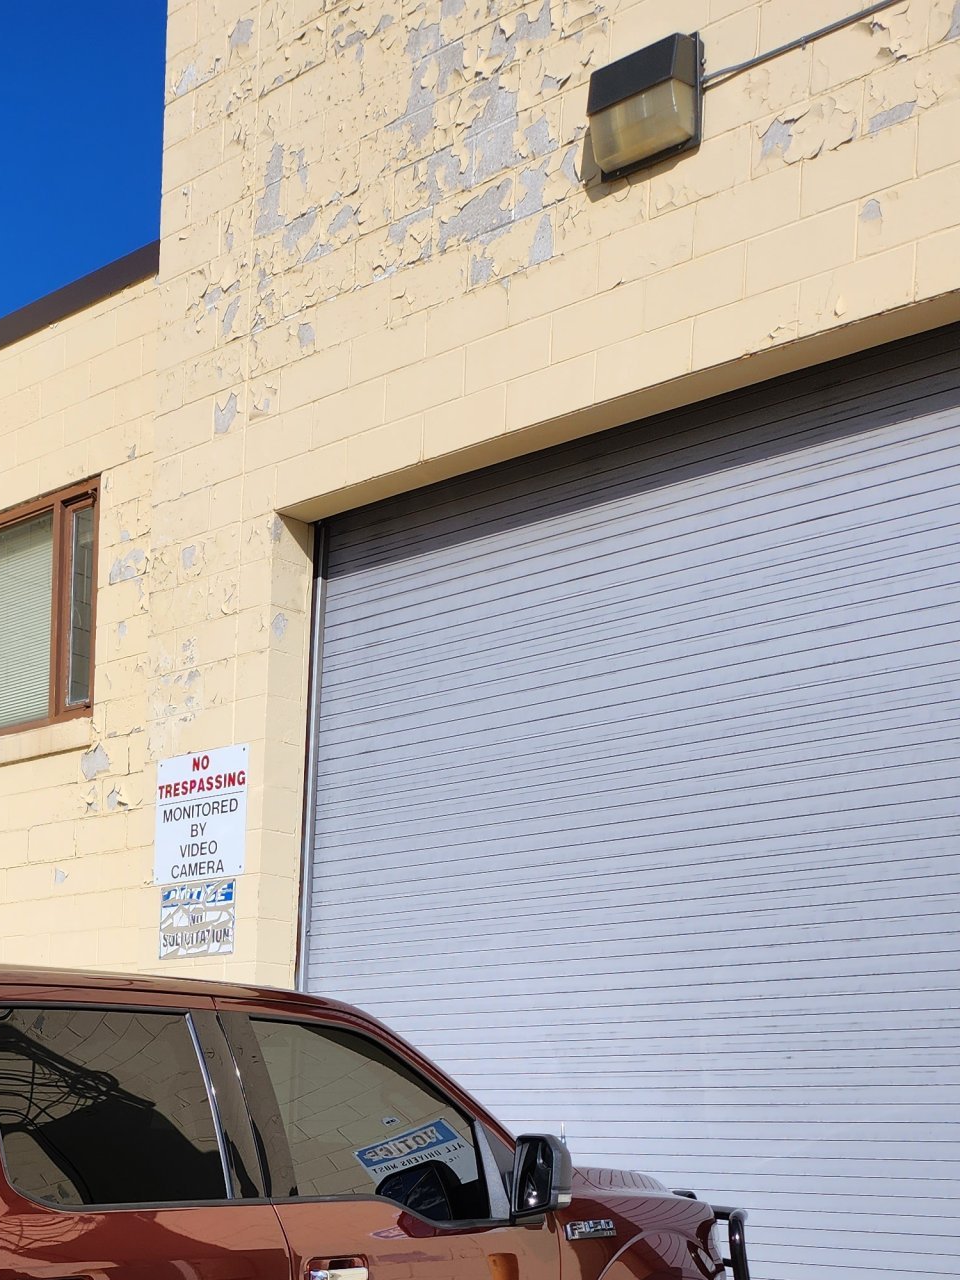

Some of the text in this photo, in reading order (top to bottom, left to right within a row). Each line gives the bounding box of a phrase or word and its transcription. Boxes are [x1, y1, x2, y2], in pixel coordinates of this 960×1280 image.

[192, 754, 210, 772] NO
[158, 770, 247, 800] TRESPASSING
[162, 798, 239, 824] MONITORED
[190, 822, 207, 838] BY
[179, 840, 218, 859] VIDEO
[170, 859, 225, 880] CAMERA
